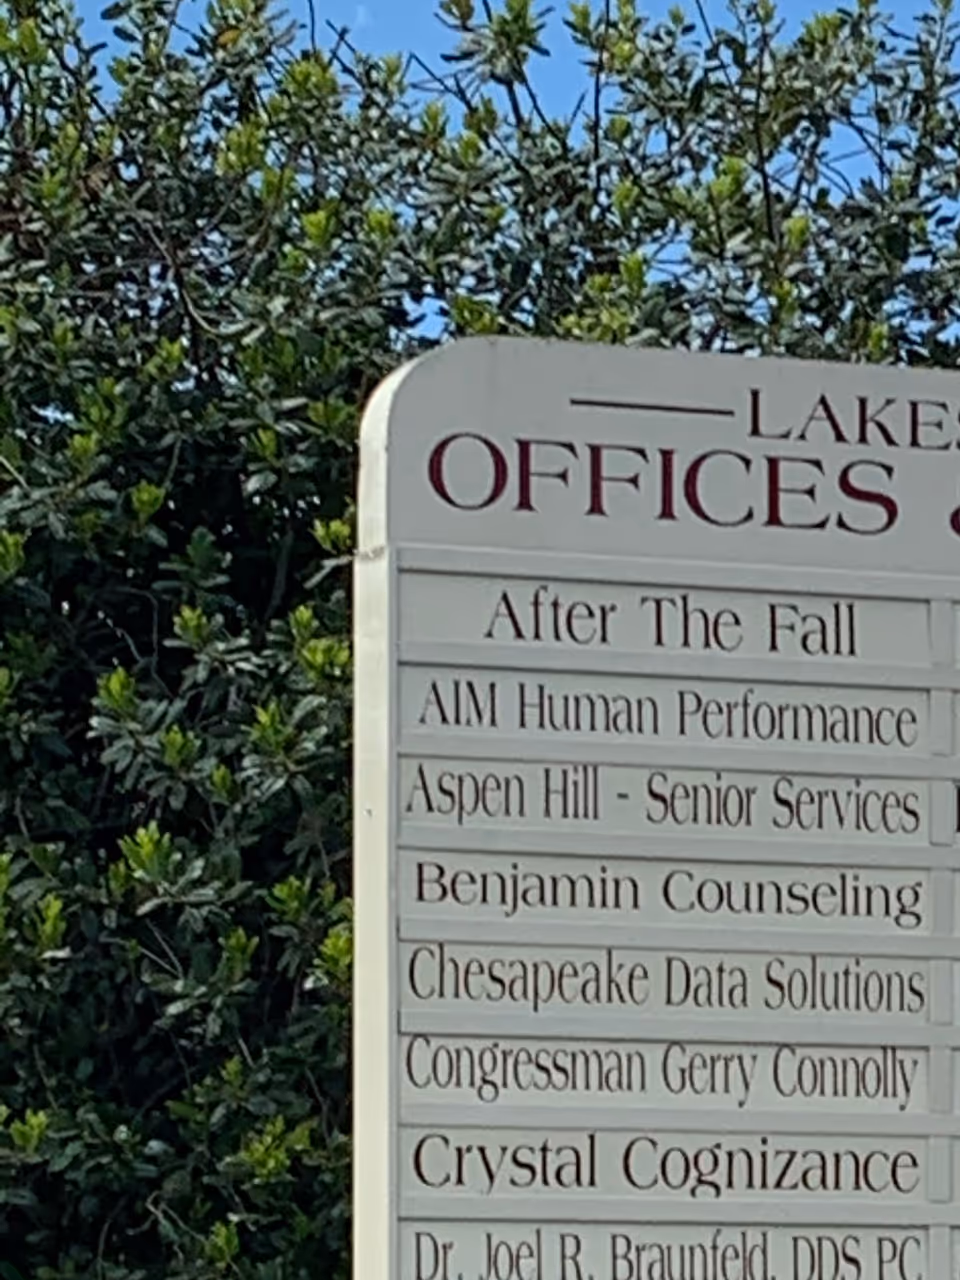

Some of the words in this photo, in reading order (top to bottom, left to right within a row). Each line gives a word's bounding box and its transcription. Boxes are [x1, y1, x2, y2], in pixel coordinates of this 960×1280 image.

[427, 432, 899, 536] OFFICES
[483, 586, 617, 647] After
[640, 594, 743, 652] The
[768, 602, 858, 657] Fall
[419, 680, 498, 729] AIM
[517, 683, 659, 736] Human
[677, 689, 918, 746] Performance
[405, 763, 526, 826] Aspen
[543, 765, 601, 821] Hill
[646, 770, 757, 828] Senior
[771, 775, 921, 834] Services
[415, 861, 641, 917] Benjamin
[662, 868, 923, 928] Counseling
[408, 942, 649, 1012] Chesapeake
[664, 956, 748, 1009] Data
[763, 954, 926, 1013] Solutions
[405, 1034, 646, 1103] Congressman
[662, 1041, 757, 1107] Gerry
[772, 1044, 919, 1112] Connolly
[413, 1130, 597, 1195] Crystal
[622, 1135, 920, 1199] Cognizance
